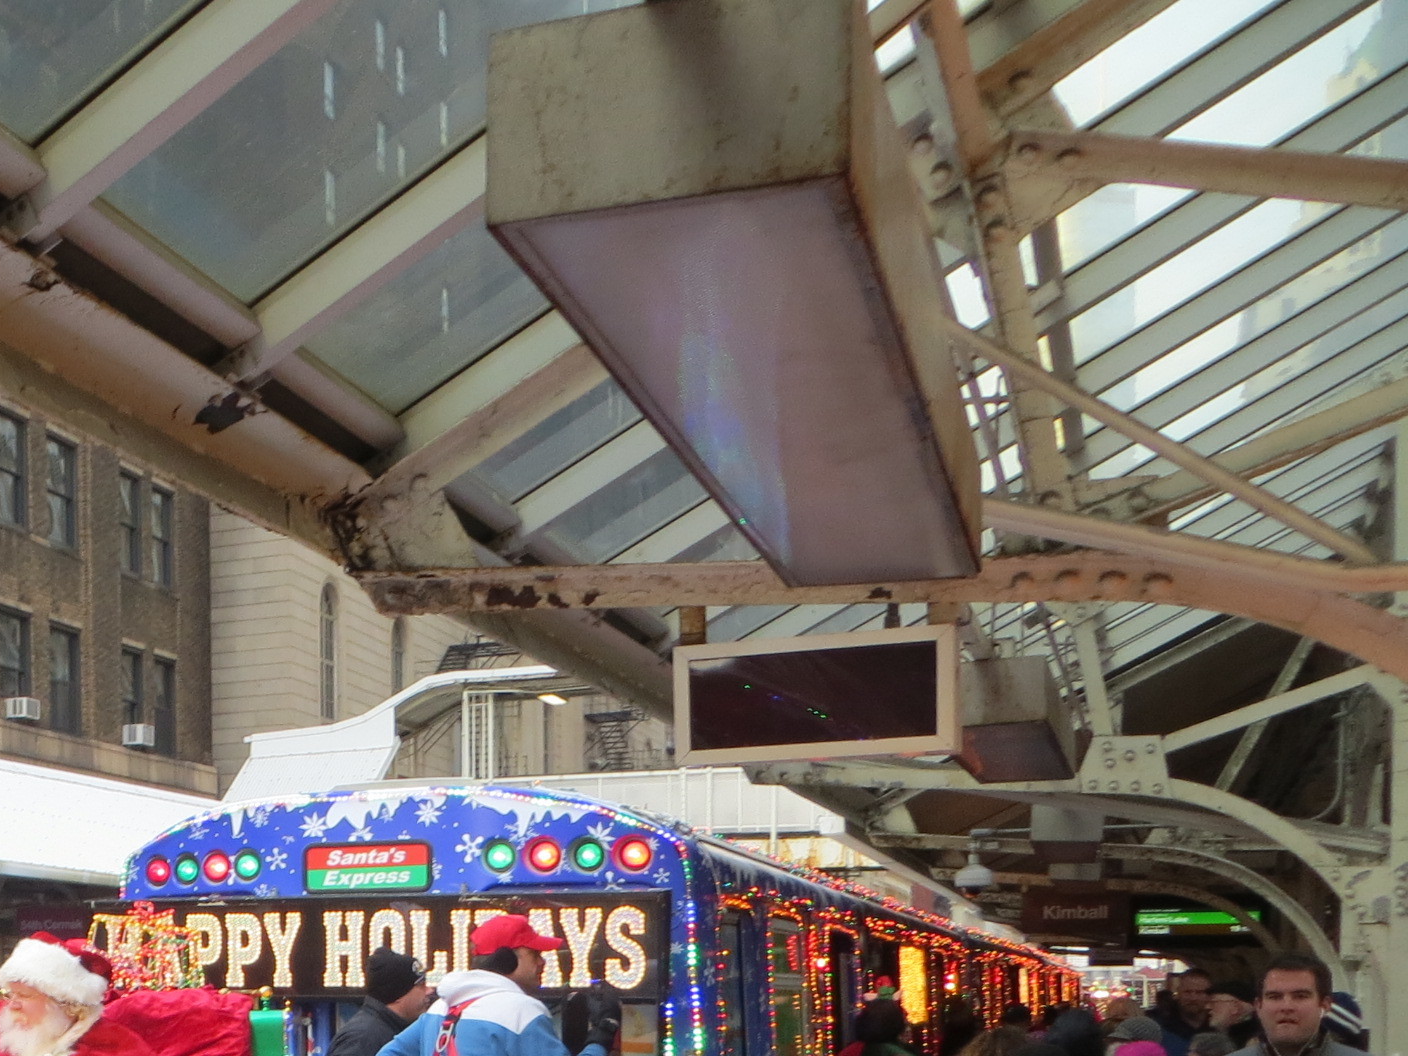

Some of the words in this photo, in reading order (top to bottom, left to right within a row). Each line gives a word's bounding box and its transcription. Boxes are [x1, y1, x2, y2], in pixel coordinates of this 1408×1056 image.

[326, 847, 407, 866] Santa's
[322, 869, 412, 889] Express
[1042, 904, 1110, 920] Kimball
[321, 903, 647, 990] HOLIAYS
